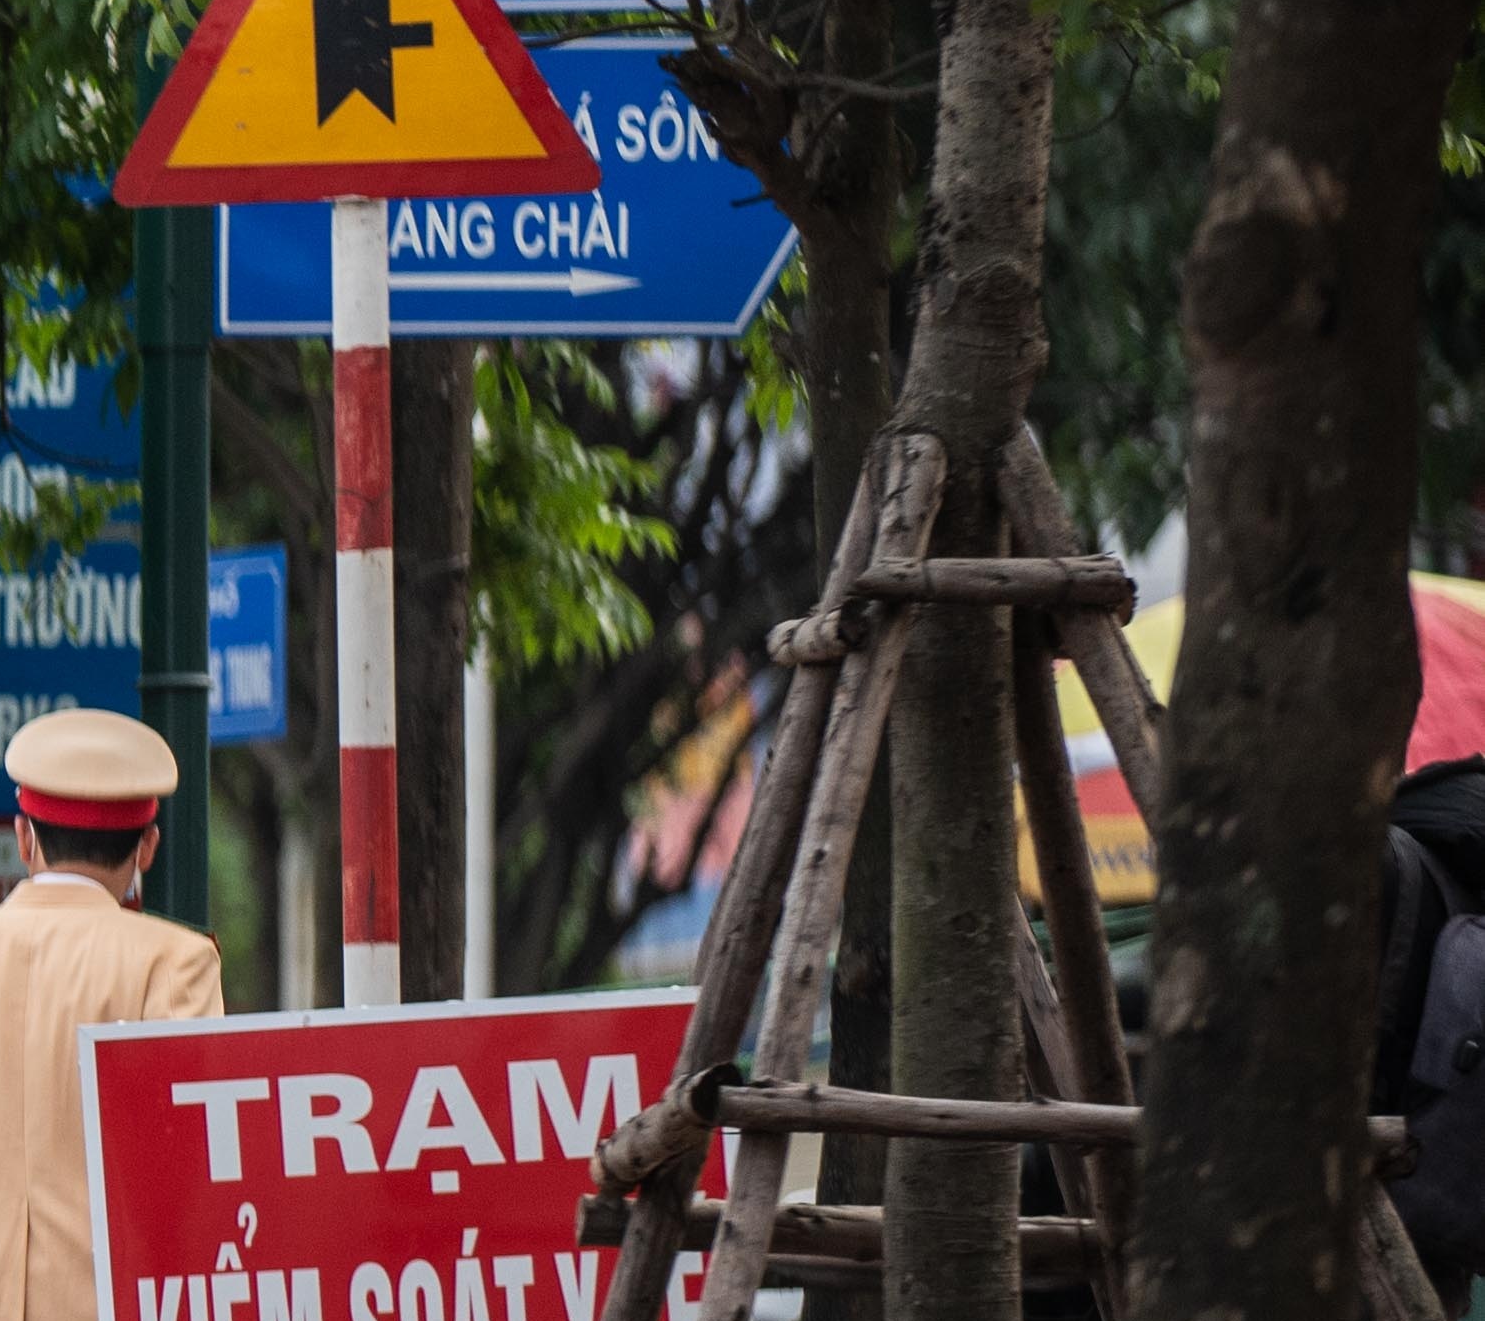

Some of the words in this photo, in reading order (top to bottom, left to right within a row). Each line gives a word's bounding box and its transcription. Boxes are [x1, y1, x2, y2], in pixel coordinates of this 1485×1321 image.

[616, 89, 720, 163] SÔN
[390, 198, 496, 260] ÀNG
[512, 189, 629, 260] CHÀI
[171, 1052, 641, 1195] TRẠM
